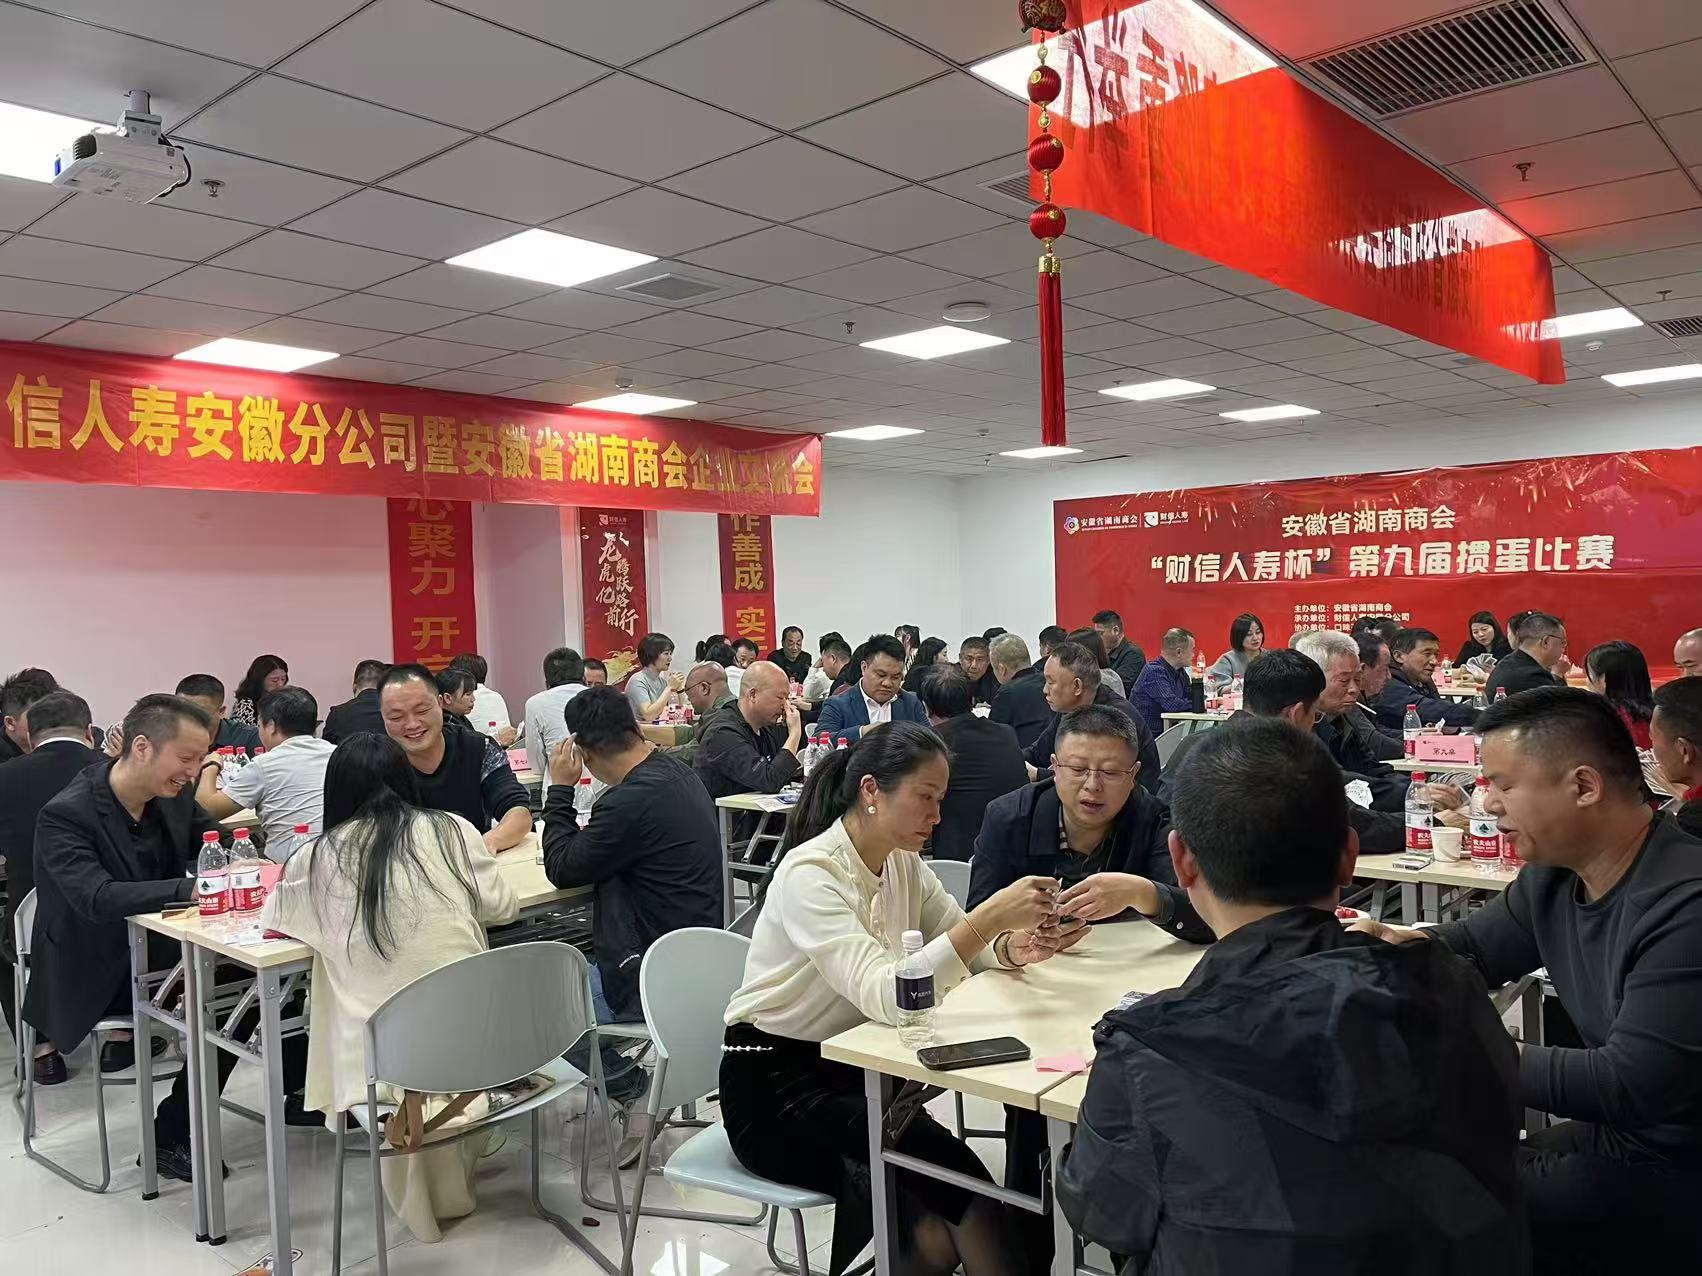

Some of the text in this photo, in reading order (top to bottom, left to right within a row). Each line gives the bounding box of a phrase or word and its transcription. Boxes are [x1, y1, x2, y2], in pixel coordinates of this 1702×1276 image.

[1281, 505, 1456, 538] 安徽省湖南商会
